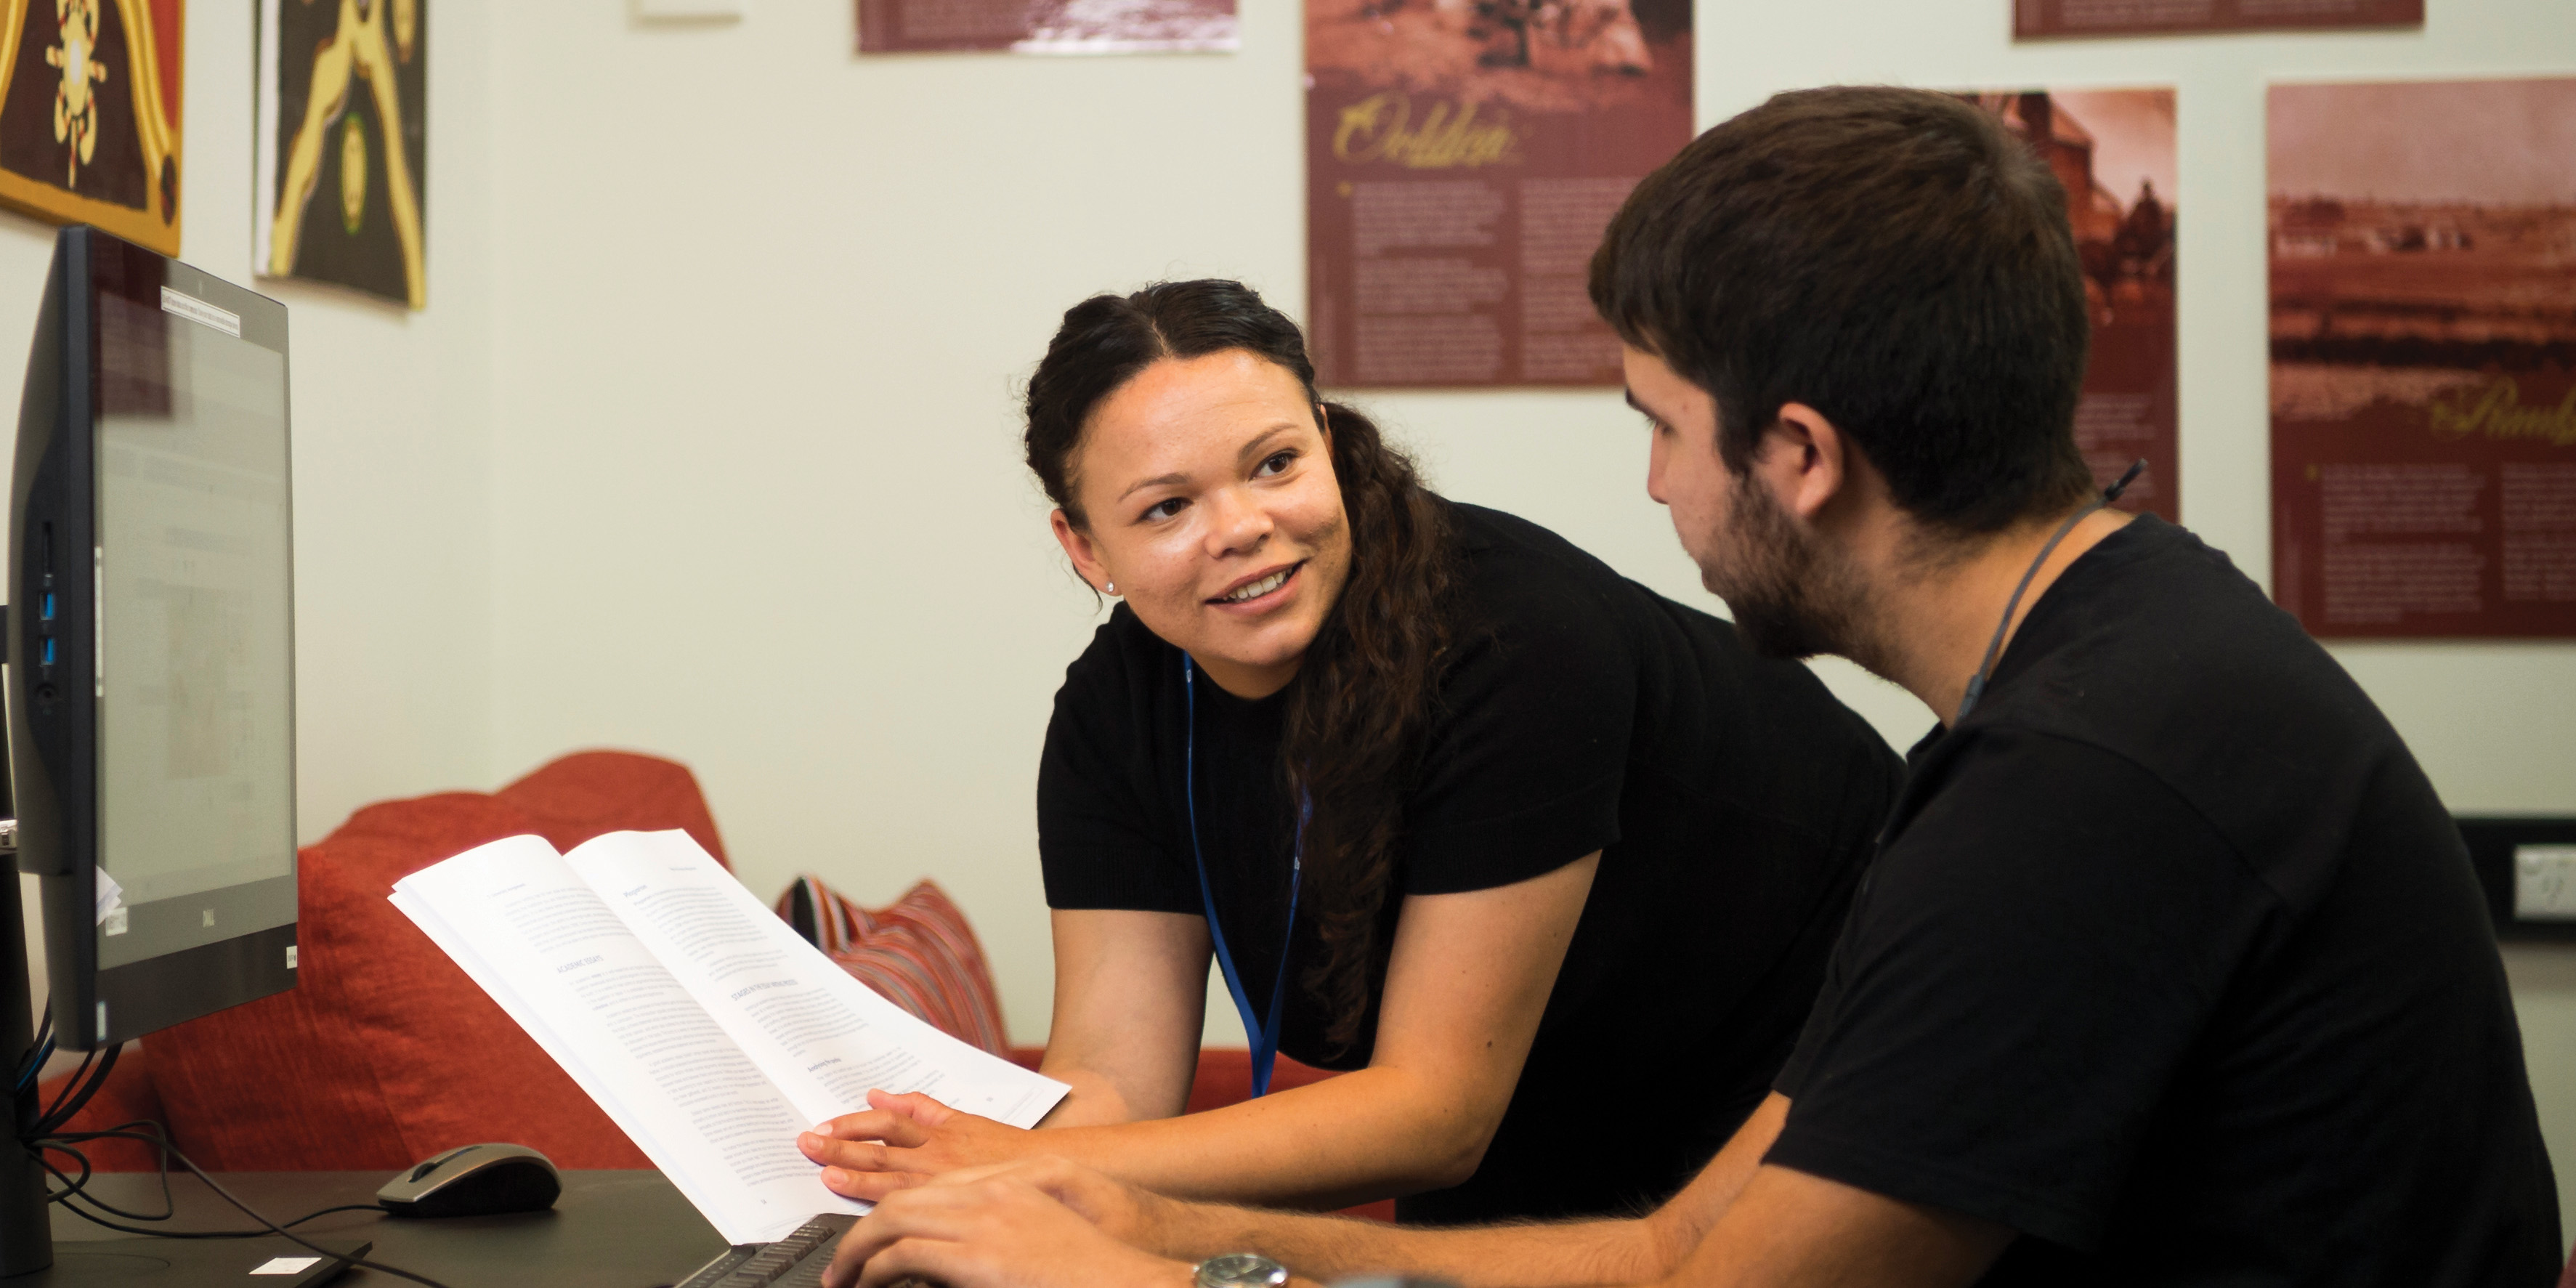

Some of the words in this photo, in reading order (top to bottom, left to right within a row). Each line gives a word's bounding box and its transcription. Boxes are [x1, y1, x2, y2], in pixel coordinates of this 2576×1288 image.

[556, 958, 586, 973] ACADEMIC
[583, 955, 604, 965] ESSAYS
[731, 988, 751, 1001] STAGES
